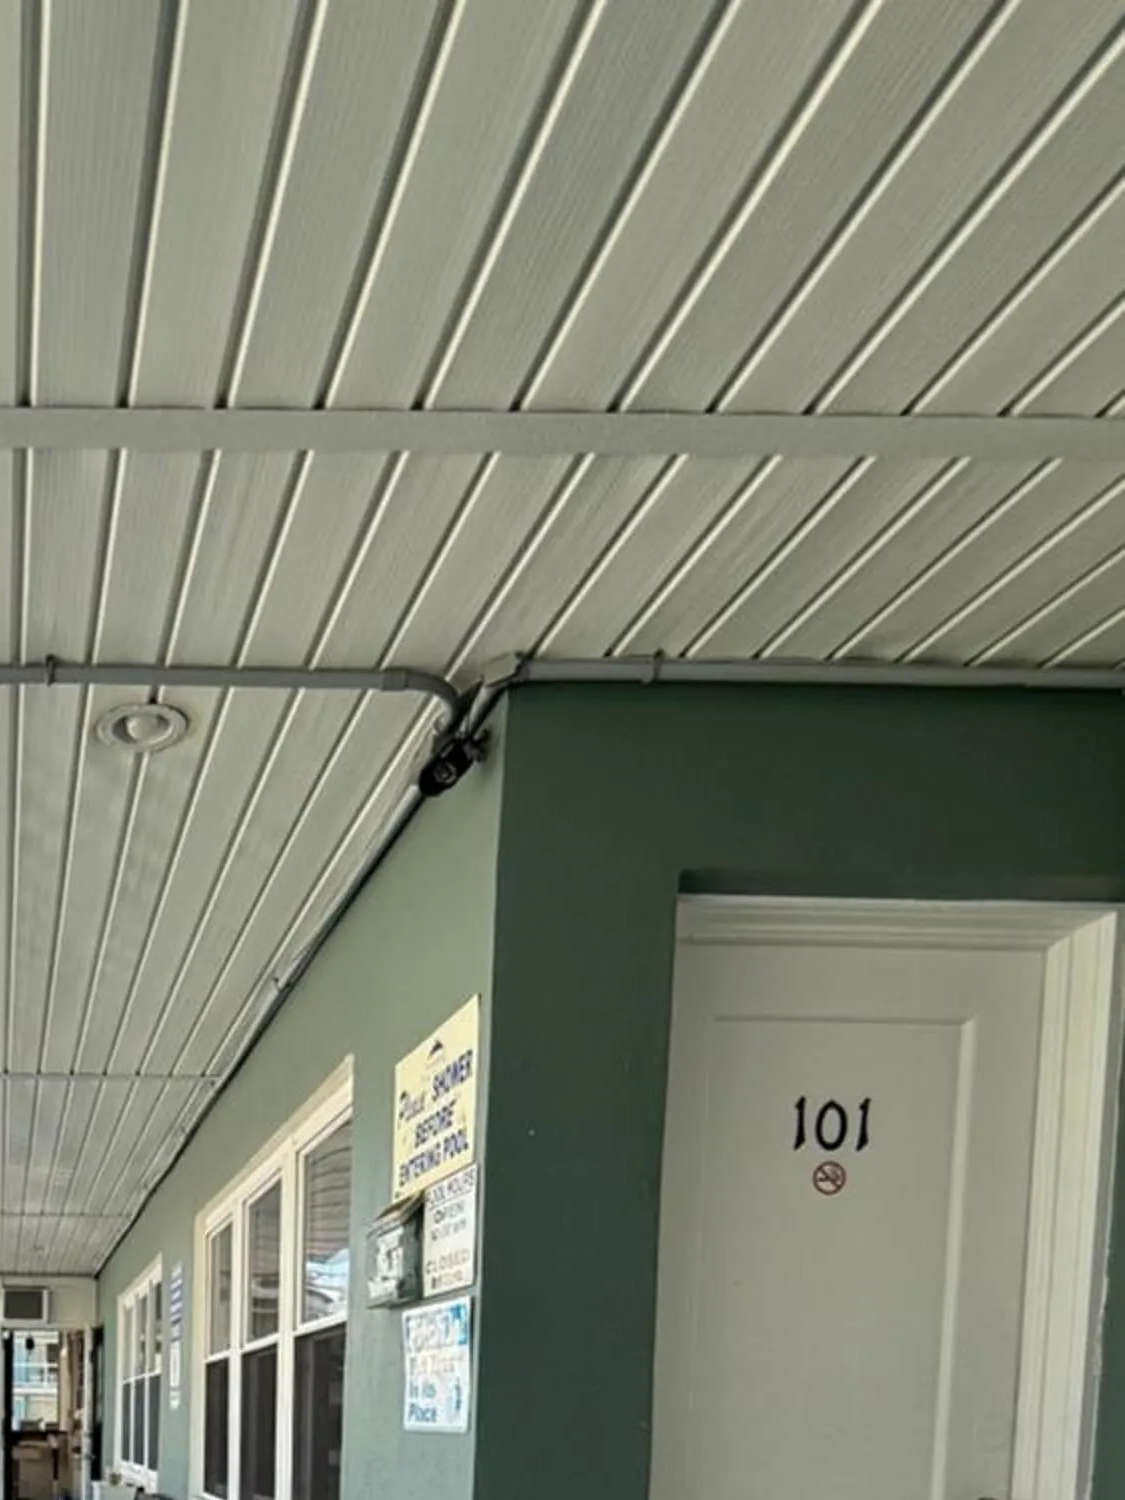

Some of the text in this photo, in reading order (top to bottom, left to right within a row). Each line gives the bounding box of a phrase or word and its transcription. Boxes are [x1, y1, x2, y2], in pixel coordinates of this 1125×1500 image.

[432, 1049, 473, 1102] SHOWER
[414, 1099, 456, 1149] BEFORE
[793, 1095, 872, 1152] 101
[398, 1128, 469, 1188] ENTERING POOL
[433, 1200, 465, 1225] OPEN
[426, 1247, 470, 1275] CLOSED
